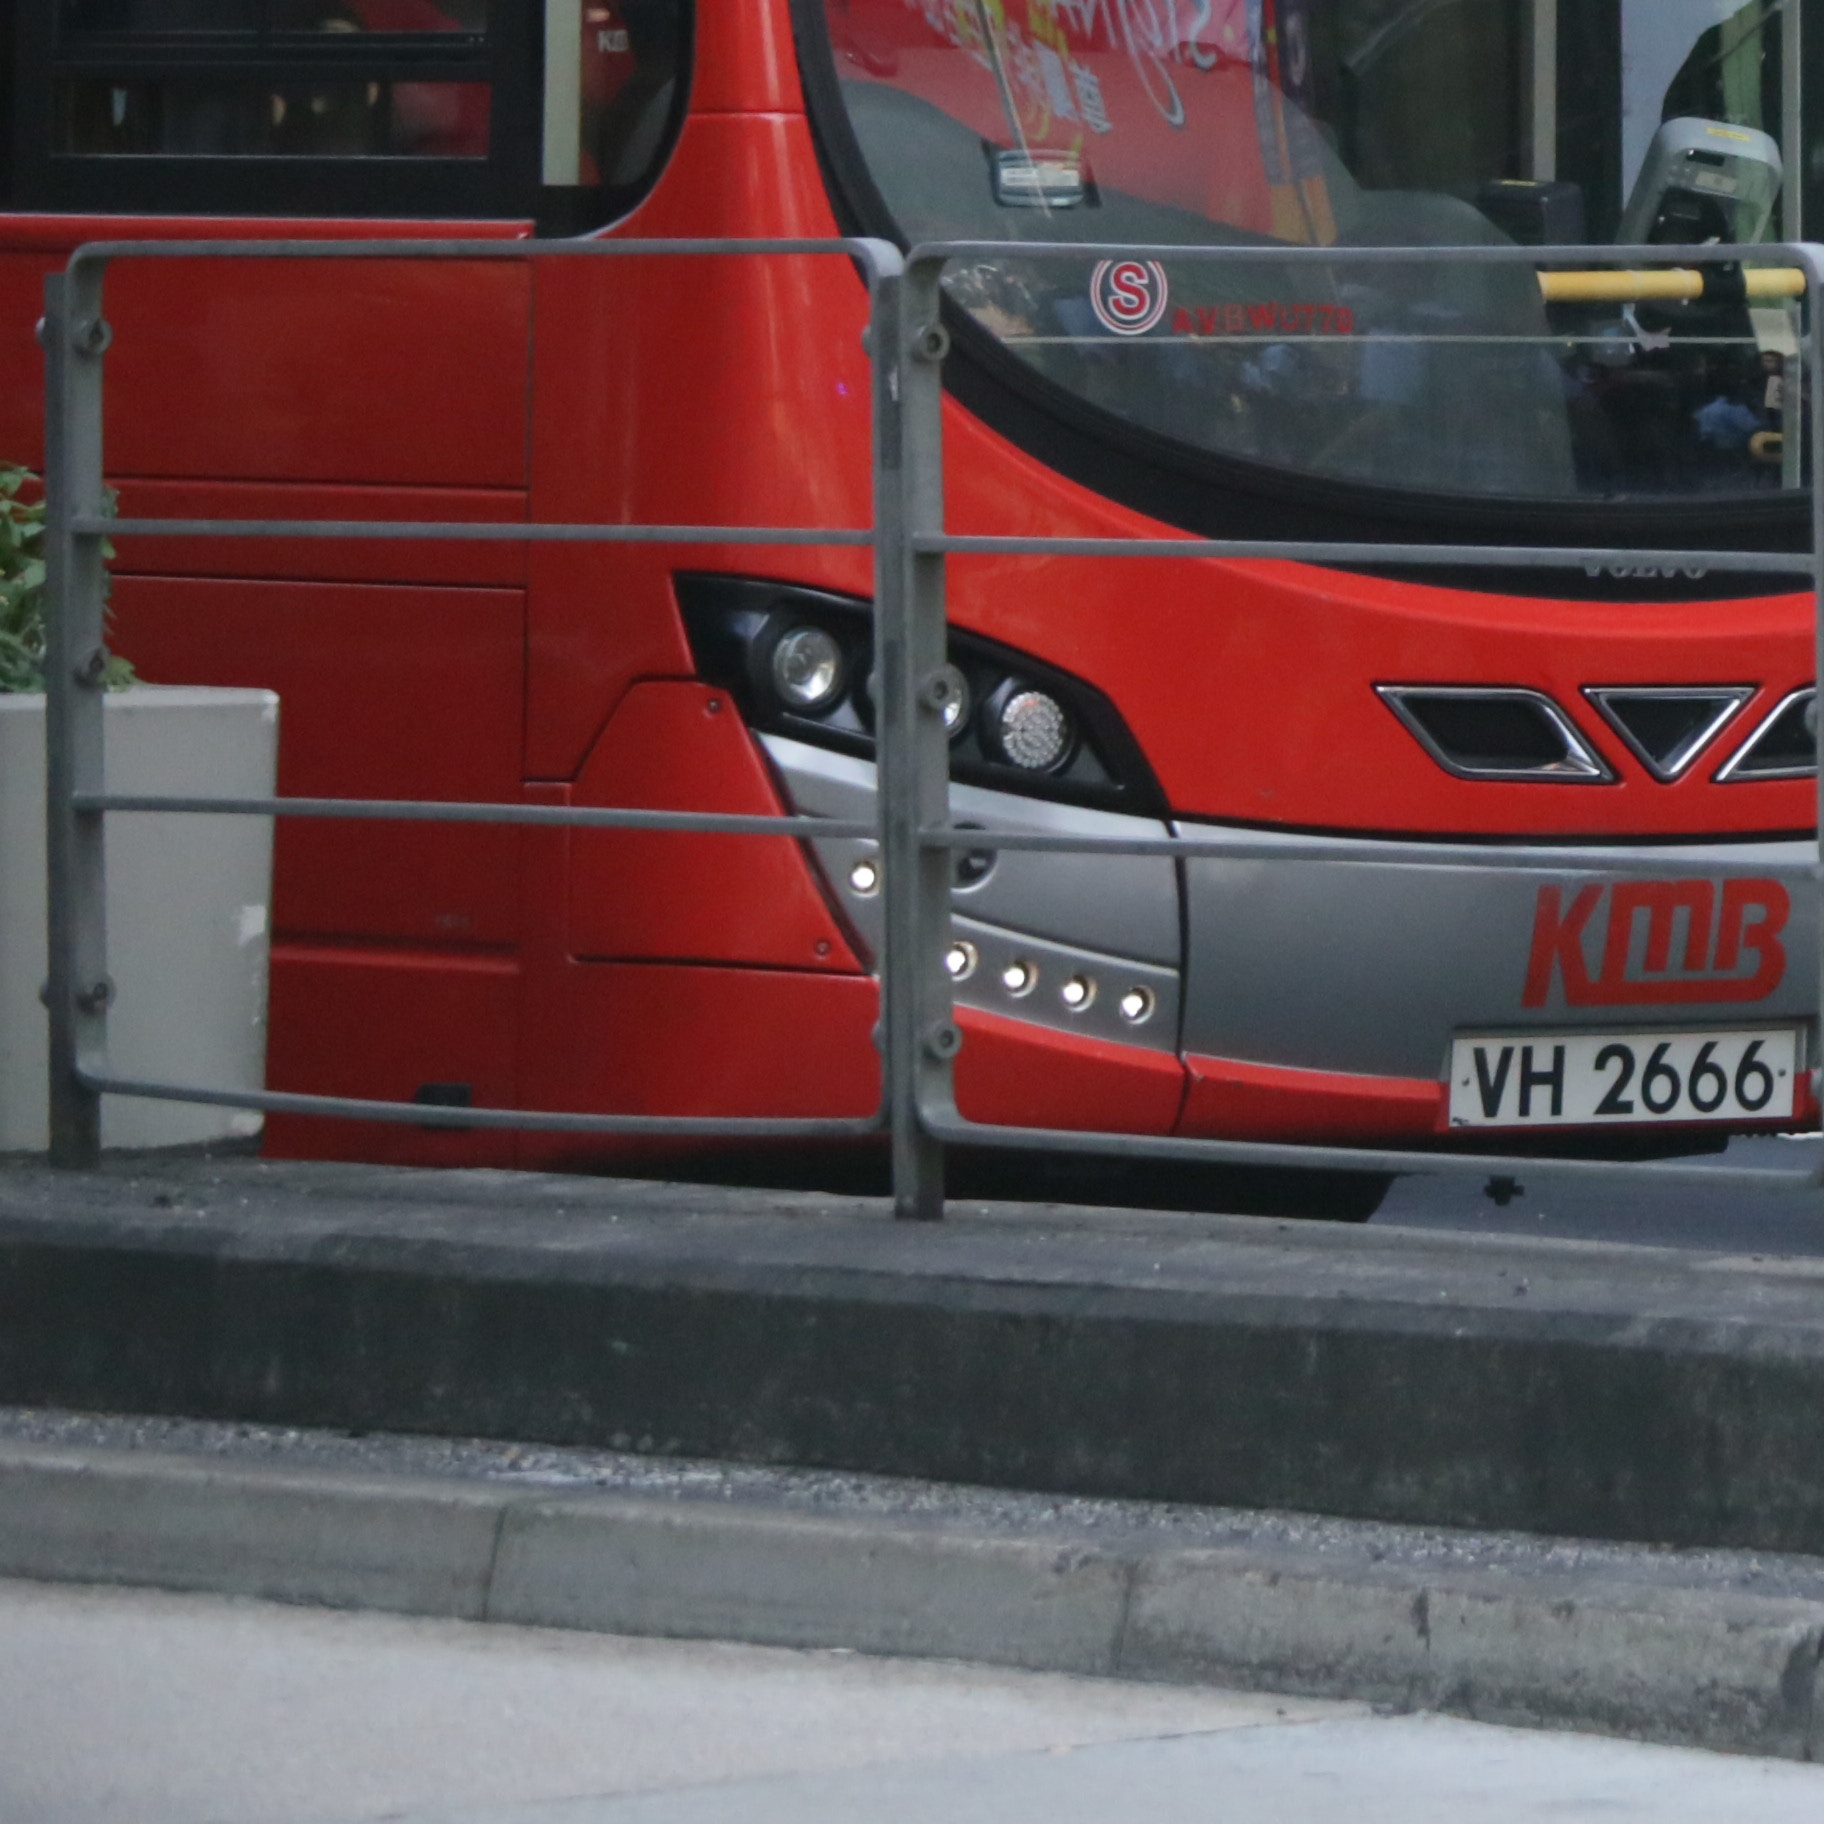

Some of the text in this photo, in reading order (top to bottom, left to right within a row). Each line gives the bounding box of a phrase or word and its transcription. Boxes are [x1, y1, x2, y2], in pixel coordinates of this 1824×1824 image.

[1522, 879, 1788, 1008] KMB
[1472, 1039, 1775, 1119] VH 2666
